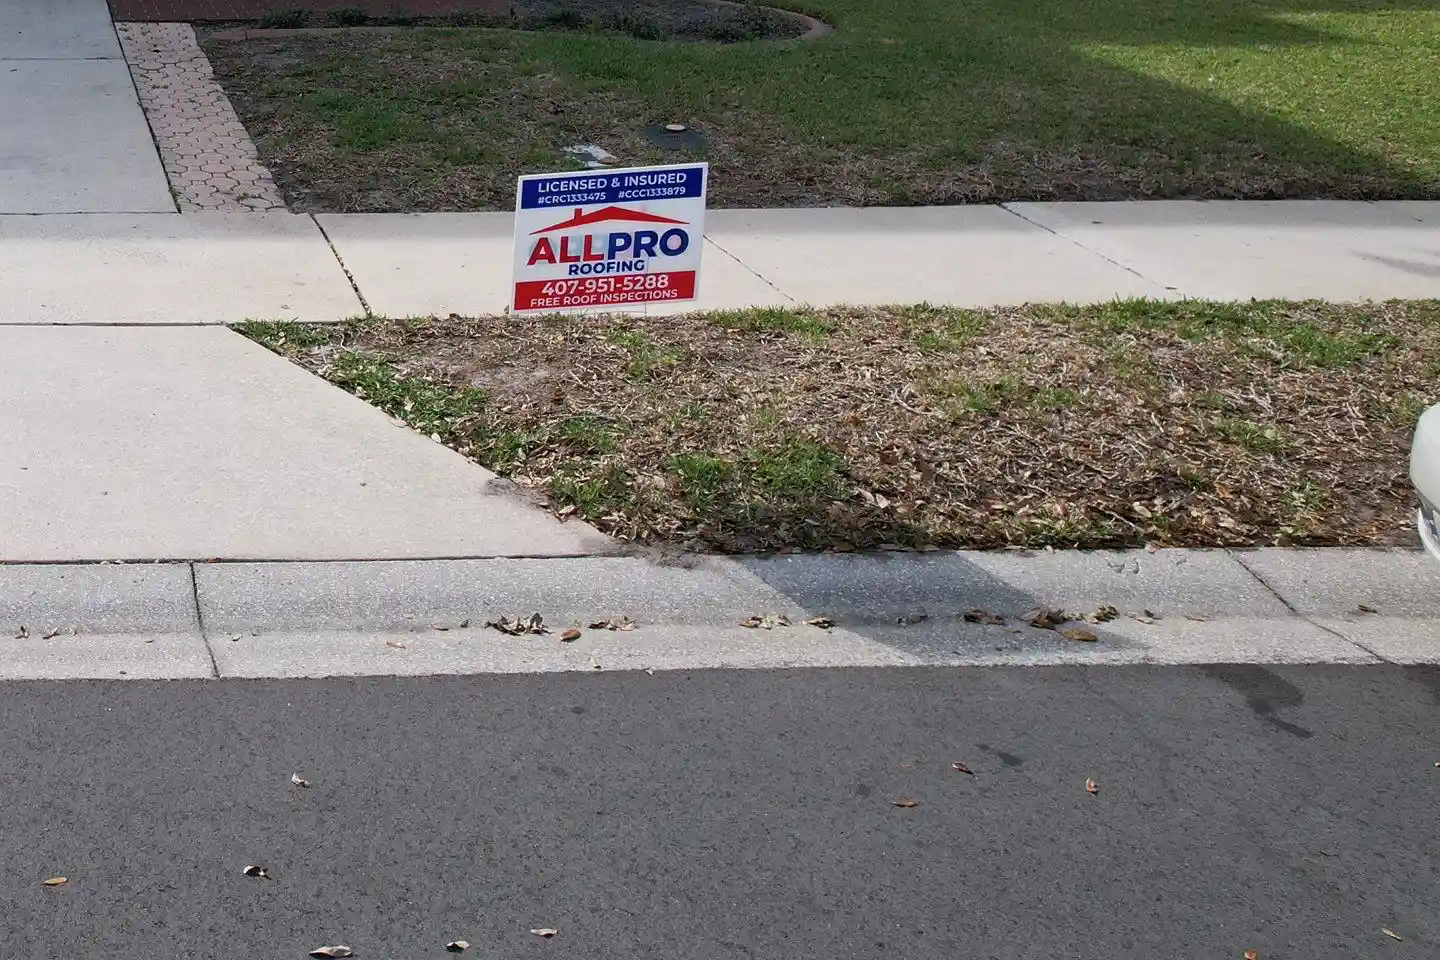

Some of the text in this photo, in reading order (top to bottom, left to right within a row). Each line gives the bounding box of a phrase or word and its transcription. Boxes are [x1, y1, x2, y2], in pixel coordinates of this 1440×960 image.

[538, 172, 687, 193] LICENSED & INSURED
[537, 187, 686, 205] #CRC1333475 #CCC1333879
[527, 228, 689, 265] ALLPRO
[568, 259, 645, 276] ROOFING
[542, 275, 669, 296] 407-951-5288
[530, 289, 678, 308] FREE ROOF INSPECTIONS
